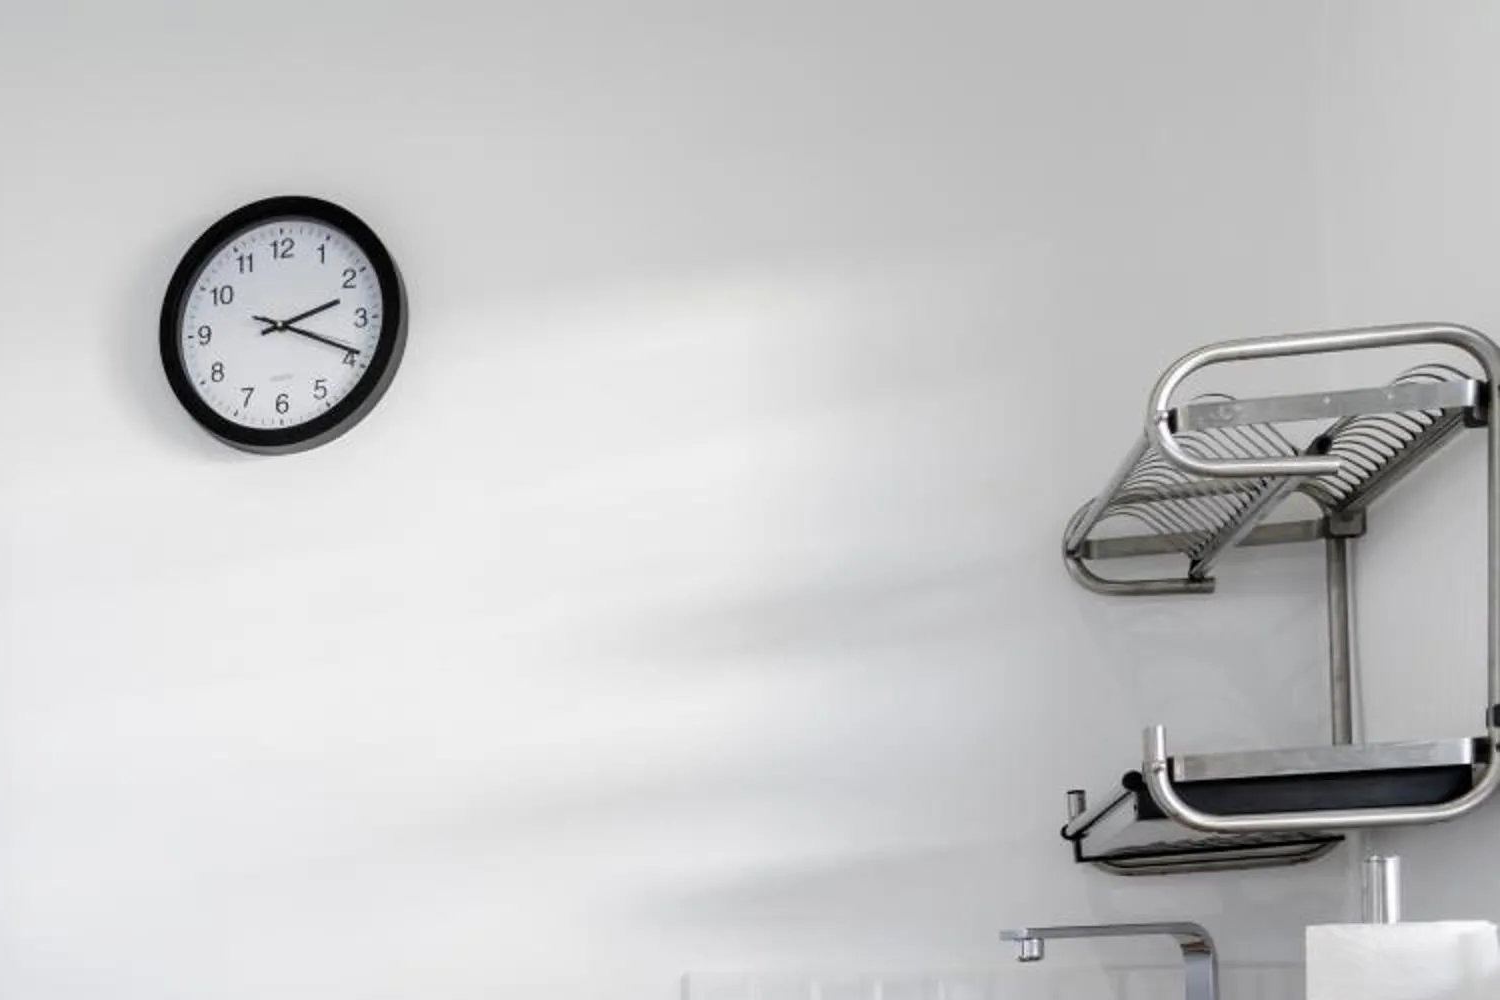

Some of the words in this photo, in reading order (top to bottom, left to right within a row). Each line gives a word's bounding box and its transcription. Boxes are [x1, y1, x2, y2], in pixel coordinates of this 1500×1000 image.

[271, 238, 294, 260] 12
[316, 243, 326, 264] 1
[236, 253, 254, 274] 11
[342, 268, 357, 289] 2
[210, 285, 234, 306] 10
[354, 307, 368, 329] 3
[197, 325, 212, 345] 9
[341, 350, 356, 367] 4
[211, 363, 225, 383] 8
[241, 387, 255, 408] 7
[313, 379, 328, 400] 5
[275, 393, 289, 414] 6
